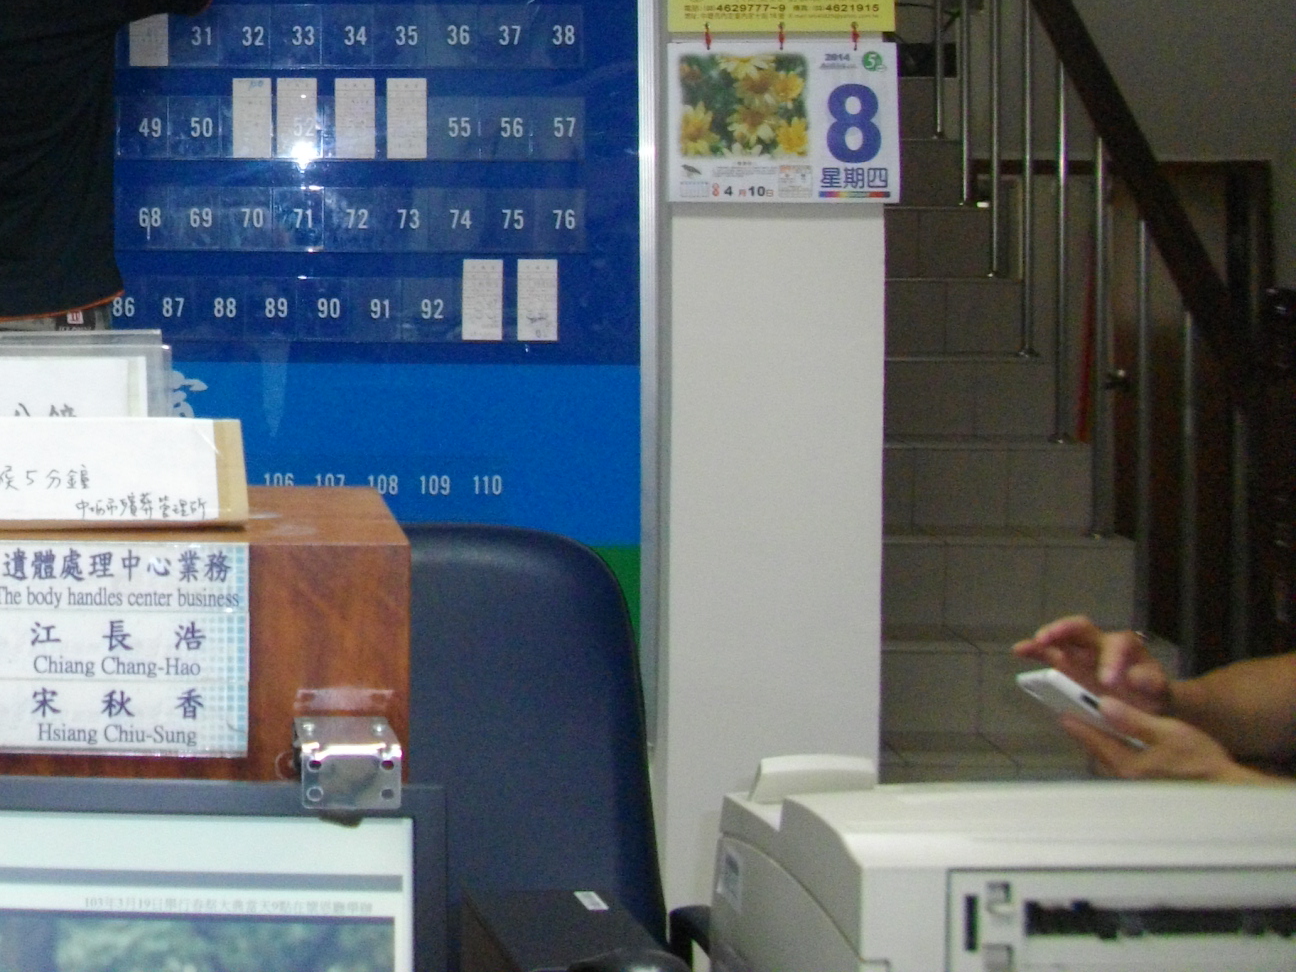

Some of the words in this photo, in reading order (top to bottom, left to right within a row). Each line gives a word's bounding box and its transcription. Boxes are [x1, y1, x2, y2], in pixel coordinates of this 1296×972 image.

[191, 26, 212, 46] 31
[242, 26, 264, 46] 32
[292, 26, 315, 46] 33
[344, 25, 367, 46] 34
[395, 25, 418, 46] 35
[447, 25, 470, 46] 36
[499, 25, 521, 45] 37
[552, 24, 575, 45] 38
[139, 117, 161, 138] 49
[190, 117, 213, 138] 50
[449, 117, 471, 138] 55
[500, 117, 523, 138] 56
[553, 117, 576, 138] 57
[826, 83, 882, 164] 8
[820, 167, 888, 189] 星期四
[139, 207, 161, 228] 68
[190, 207, 212, 228] 69
[241, 208, 264, 228] 70
[294, 208, 313, 228] 71
[346, 208, 369, 229] 72
[398, 209, 420, 229] 73
[450, 209, 472, 229] 74
[502, 209, 524, 229] 75
[553, 209, 576, 229] 76
[112, 297, 135, 317] 86
[162, 297, 185, 318] 87
[213, 298, 237, 318] 88
[265, 297, 288, 318] 89
[317, 298, 340, 318] 90
[370, 298, 390, 319] 91
[421, 299, 444, 319] 92
[367, 474, 399, 495] 108
[419, 475, 450, 496] 109
[473, 474, 502, 496] 110
[3, 547, 232, 583] 遺體處理中心業務
[26, 586, 62, 609] body
[67, 587, 124, 607] handles
[127, 590, 173, 608] center
[178, 588, 241, 608] business
[30, 620, 207, 652] 江長浩
[33, 655, 95, 677] Chiang
[101, 656, 201, 678] Chang-Hao
[30, 687, 206, 721] 宋秋香
[38, 723, 98, 745] Hsiang
[104, 724, 198, 747] Chiu-Sung
